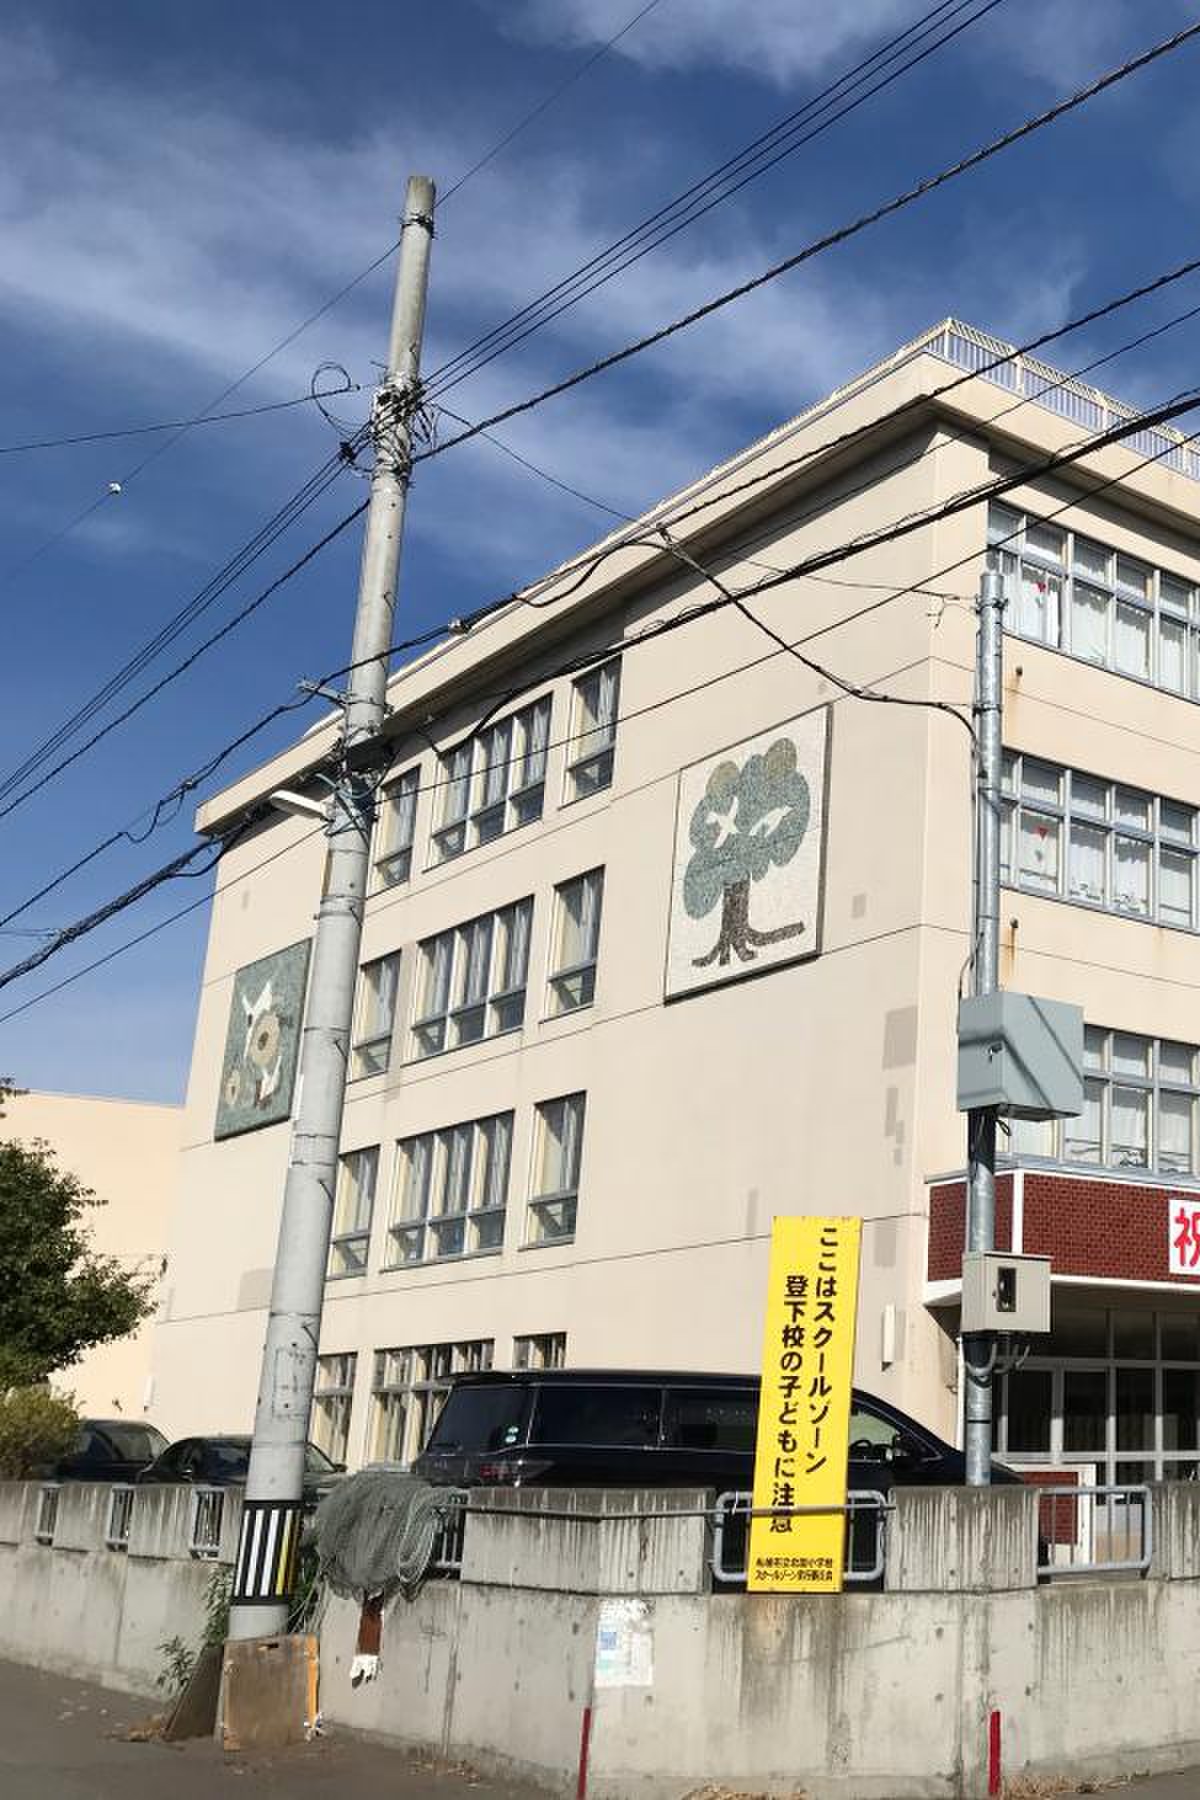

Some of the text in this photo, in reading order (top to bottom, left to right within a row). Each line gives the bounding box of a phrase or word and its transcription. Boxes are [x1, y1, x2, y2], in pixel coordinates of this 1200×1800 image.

[805, 1227, 839, 1474] ここはスクールゾーン
